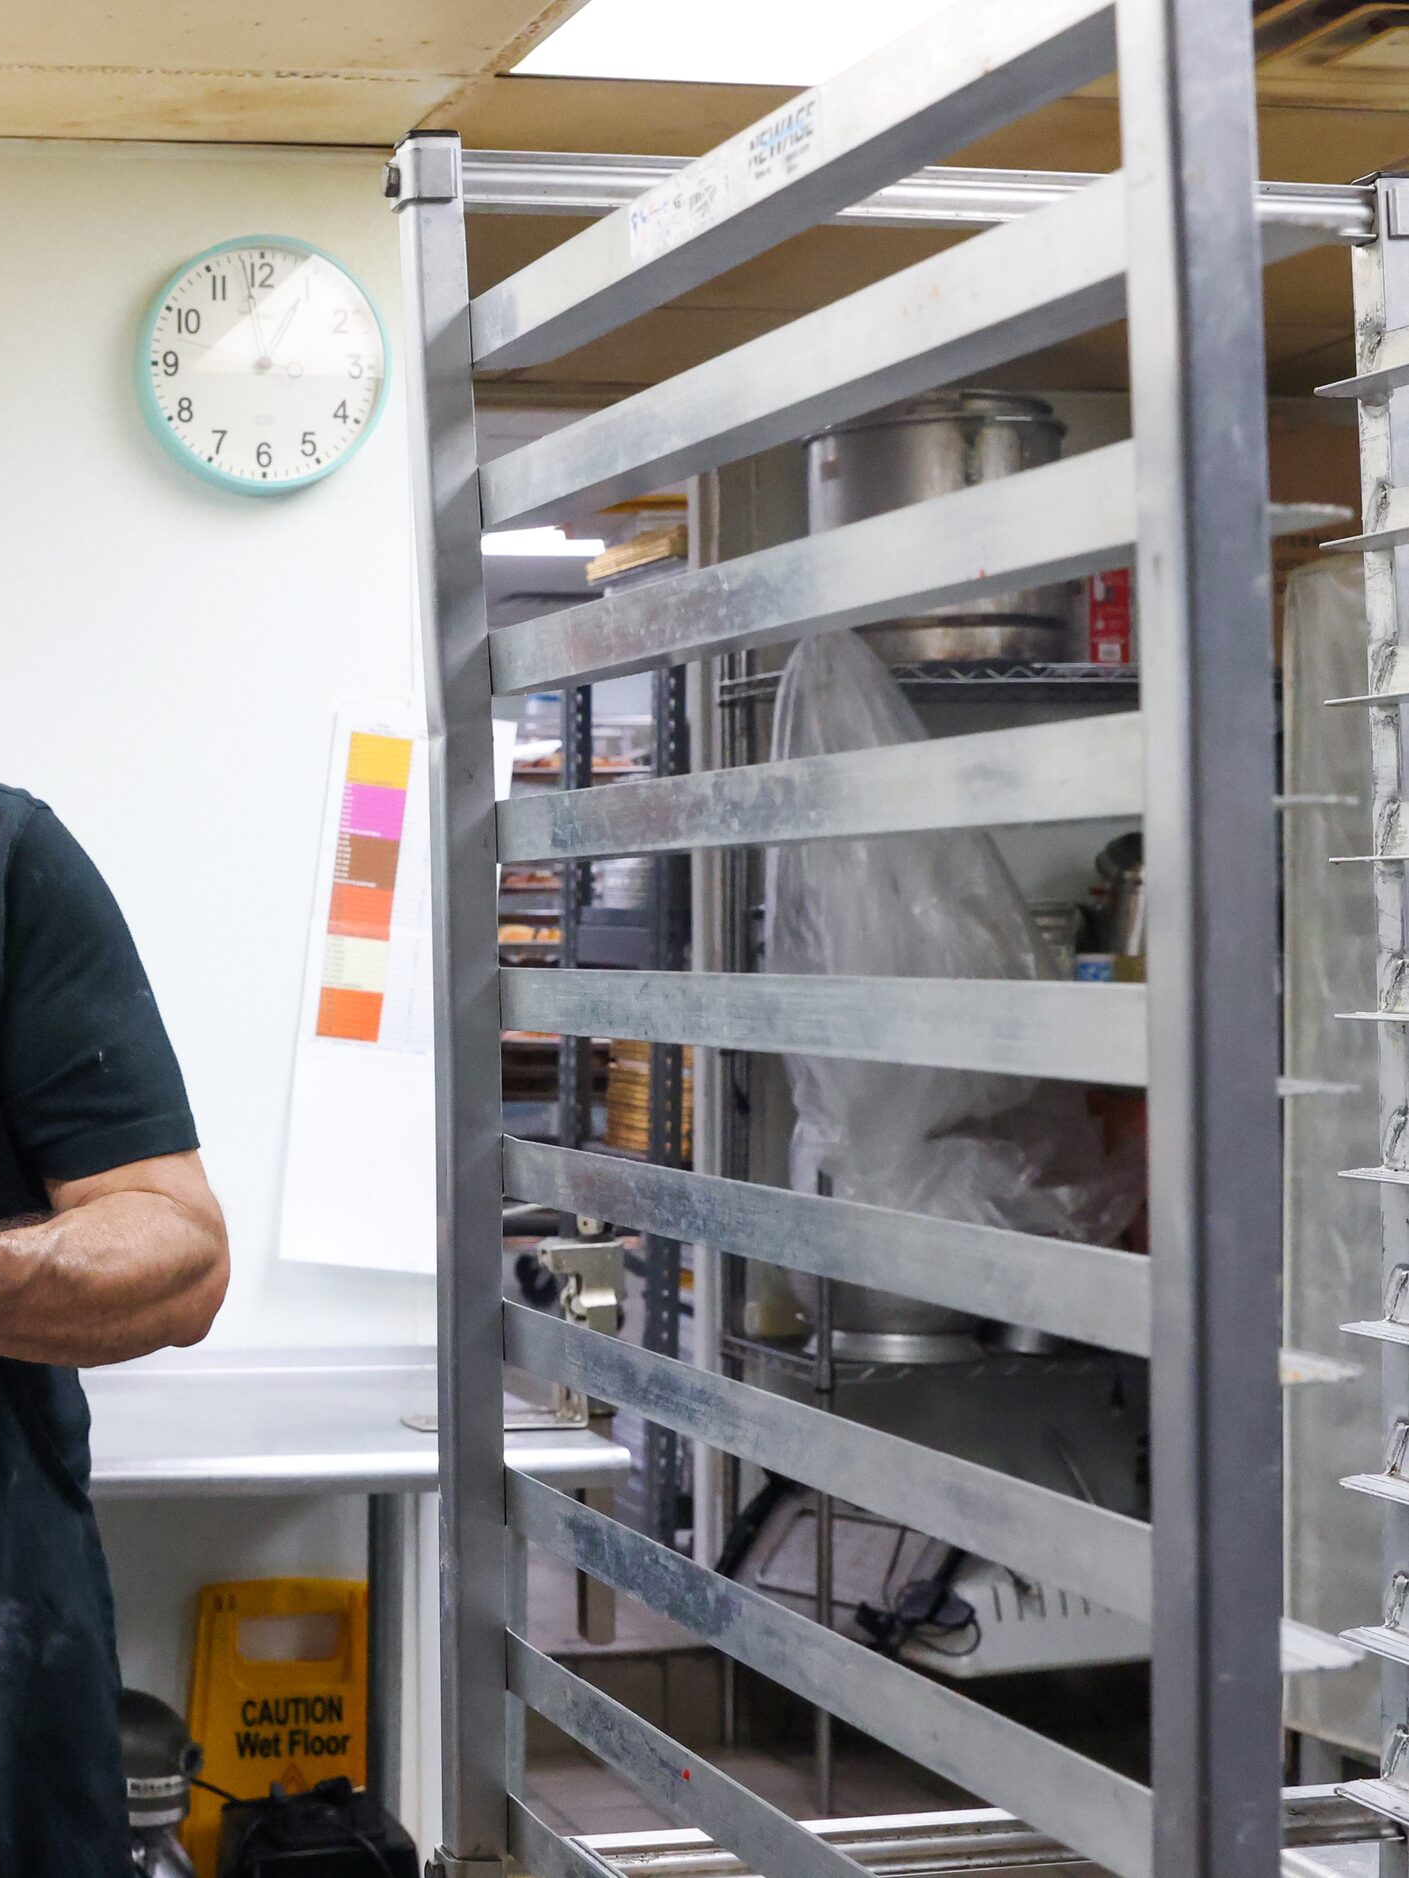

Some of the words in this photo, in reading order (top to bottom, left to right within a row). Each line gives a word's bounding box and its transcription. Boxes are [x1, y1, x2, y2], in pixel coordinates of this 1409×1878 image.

[211, 275, 227, 301] 11
[250, 262, 275, 288] 12
[176, 308, 201, 334] 10
[332, 309, 349, 334] 2
[162, 350, 179, 376] 9
[348, 354, 363, 379] 3
[177, 397, 193, 423] 8
[332, 400, 349, 424] 4
[211, 430, 228, 455] 7
[256, 442, 272, 468] 6
[300, 432, 317, 457] 5
[242, 1696, 343, 1727] CAUTION
[236, 1731, 281, 1759] Wet
[288, 1729, 351, 1756] Floor
